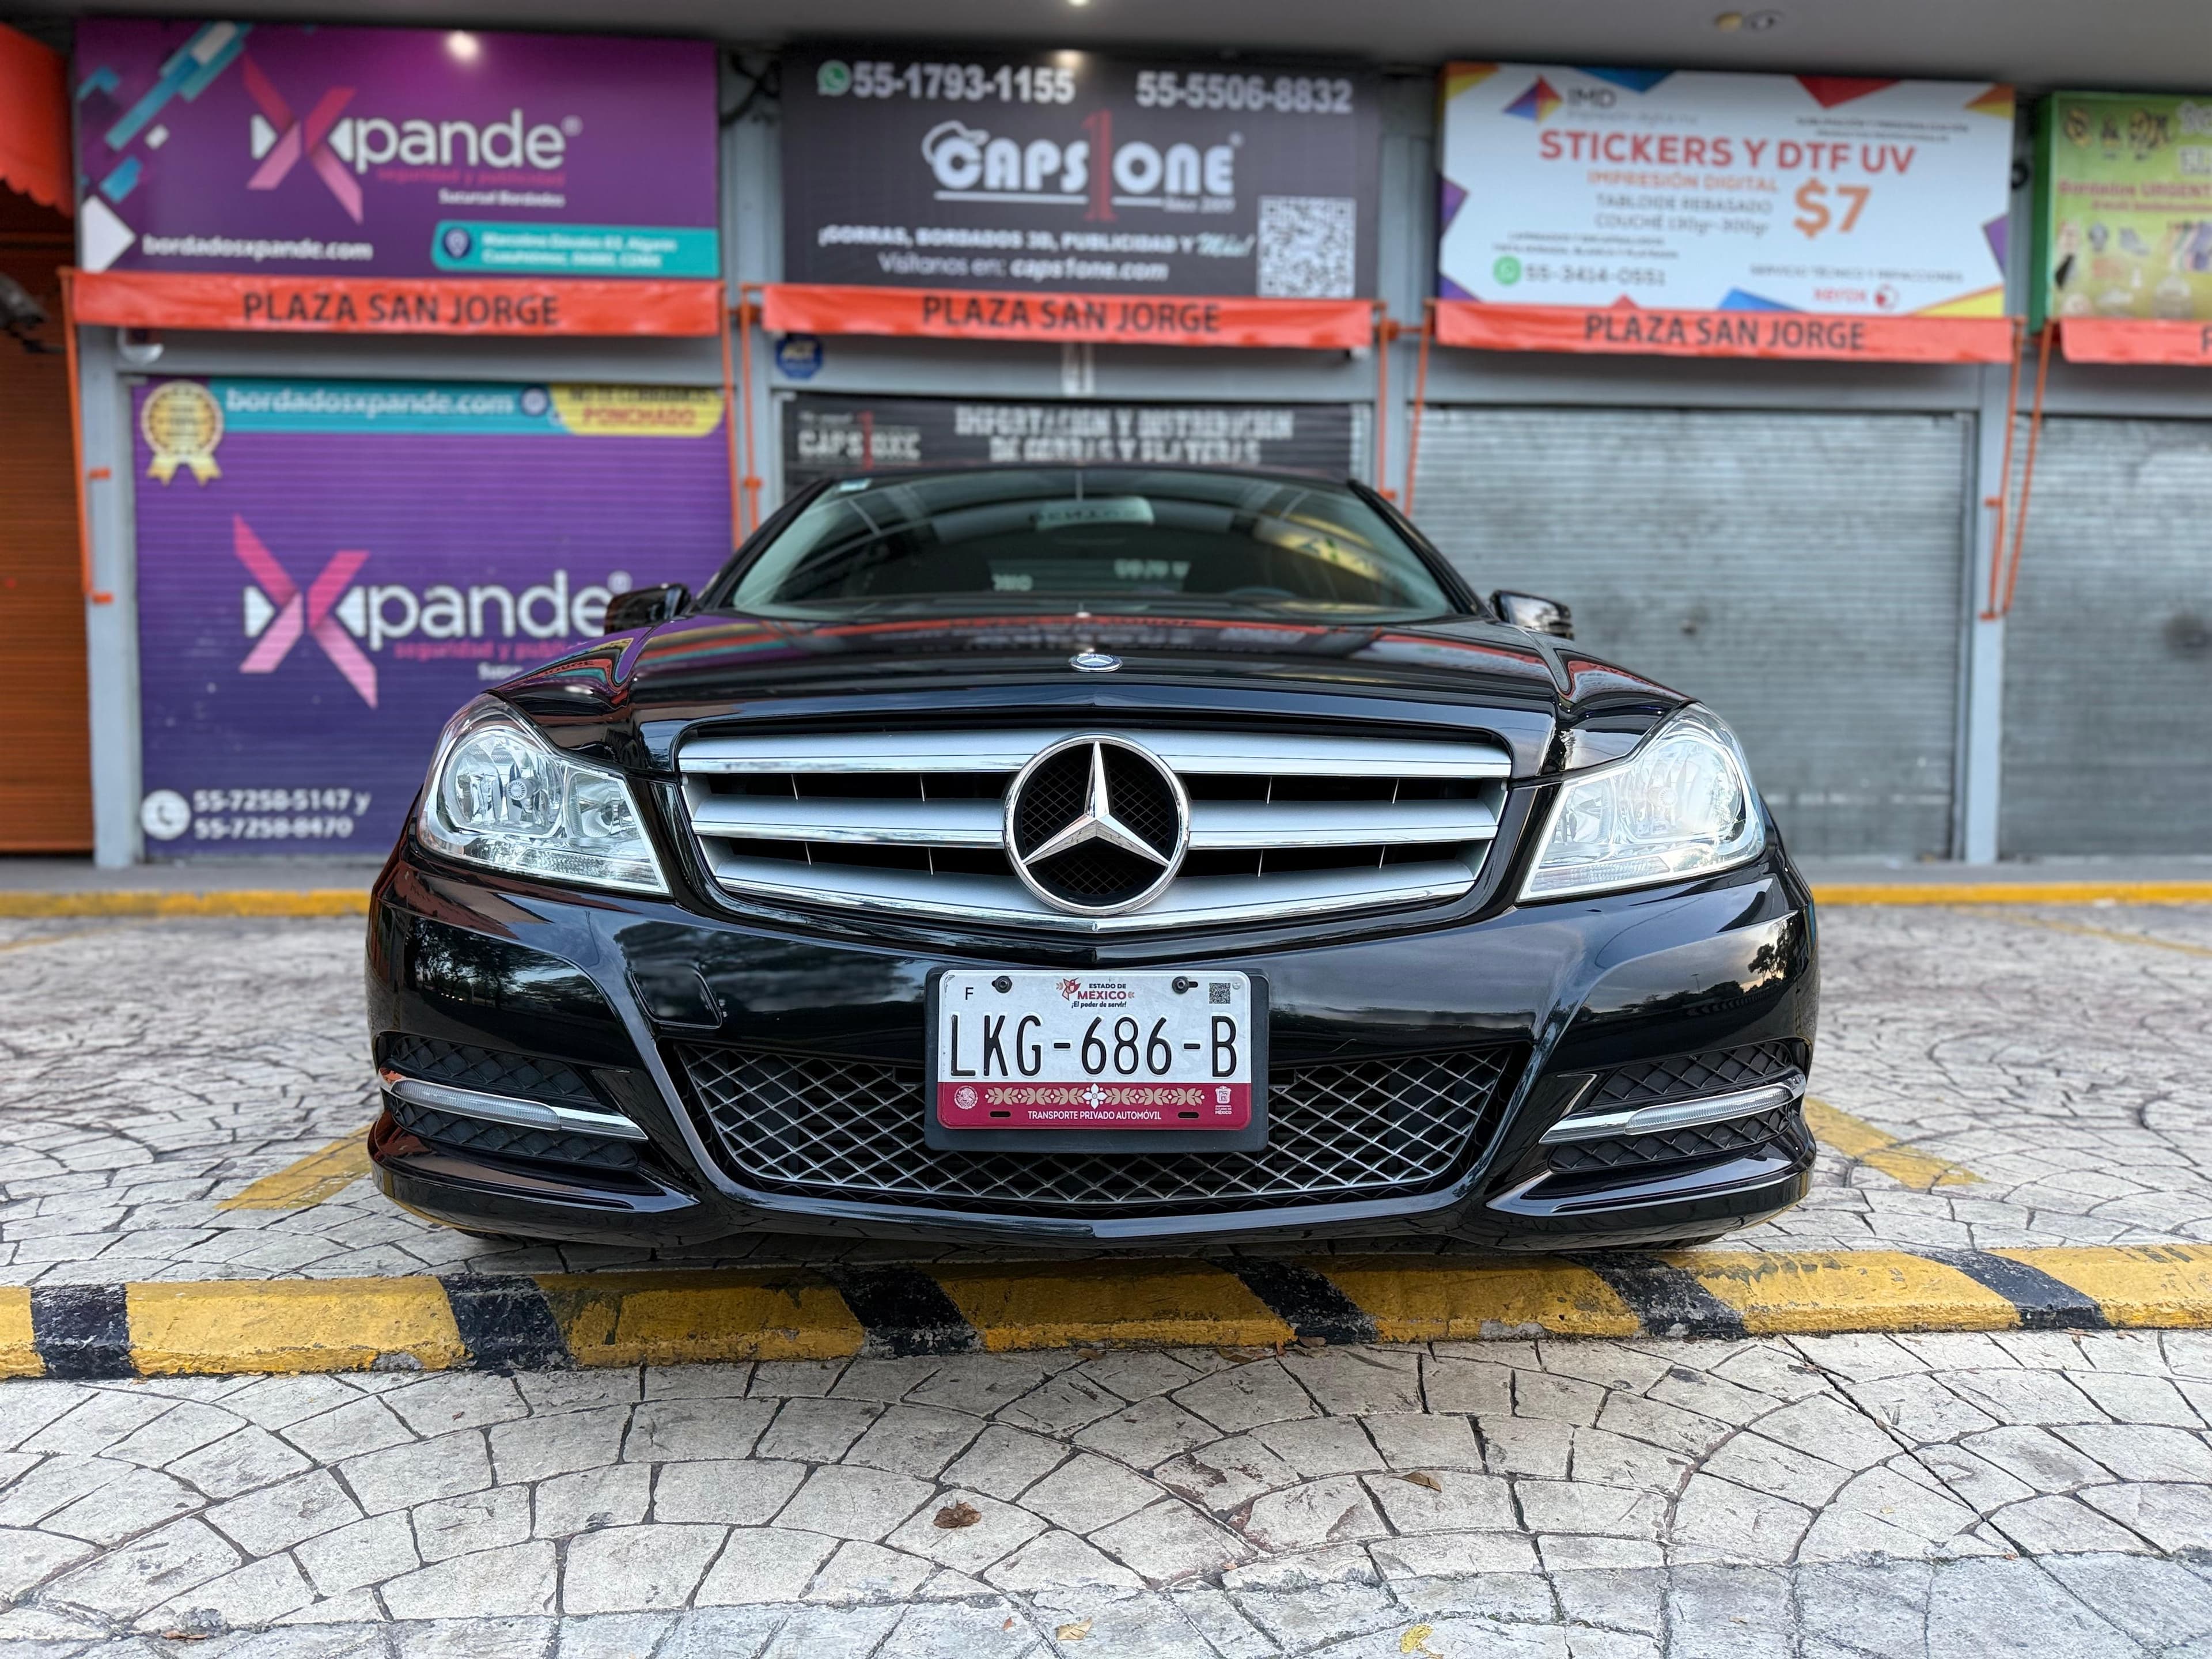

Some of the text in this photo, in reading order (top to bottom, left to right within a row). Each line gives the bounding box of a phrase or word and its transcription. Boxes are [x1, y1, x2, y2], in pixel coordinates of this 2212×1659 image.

[852, 61, 1076, 104] 55-1793-1155
[1136, 71, 1354, 113] 55-5506-8832
[1540, 130, 1916, 175] STICKERS Y DTF UV
[1793, 177, 1872, 240] $7
[142, 233, 373, 263] bordadosxpande.com
[243, 293, 559, 326] PLAZA SAN JORGE
[923, 295, 1220, 334] PLAZA SAN JORGE
[1585, 313, 1865, 350] PLAZA SAN JORGE
[226, 388, 514, 419] bordadosxpande.com
[354, 791, 372, 816] y
[965, 987, 974, 1000] F
[950, 1014, 1238, 1078] LKG-686-B
[1028, 1108, 1162, 1120] TRANSPORTE PRIVADO AUTOMÓVIL
